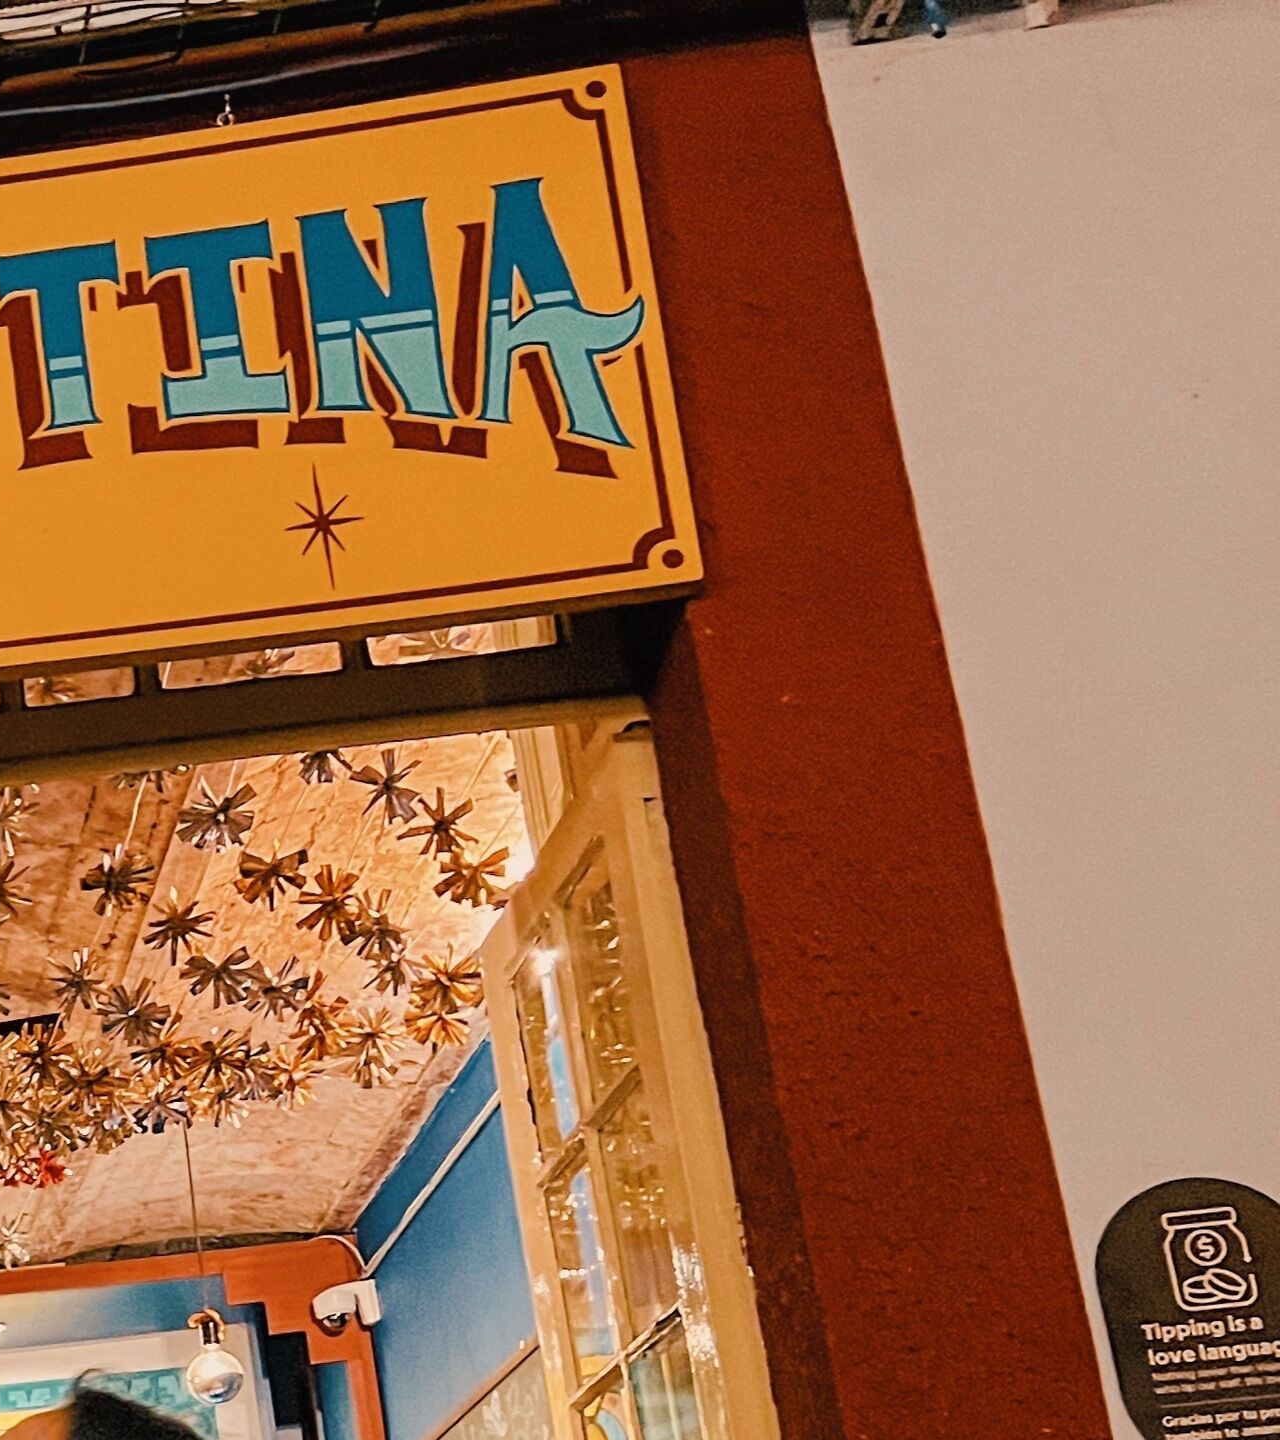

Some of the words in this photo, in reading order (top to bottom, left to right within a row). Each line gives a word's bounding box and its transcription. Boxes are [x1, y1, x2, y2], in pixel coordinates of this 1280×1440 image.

[1141, 1319, 1226, 1343] Tipping
[1249, 1316, 1264, 1331] a
[1147, 1348, 1197, 1366] love
